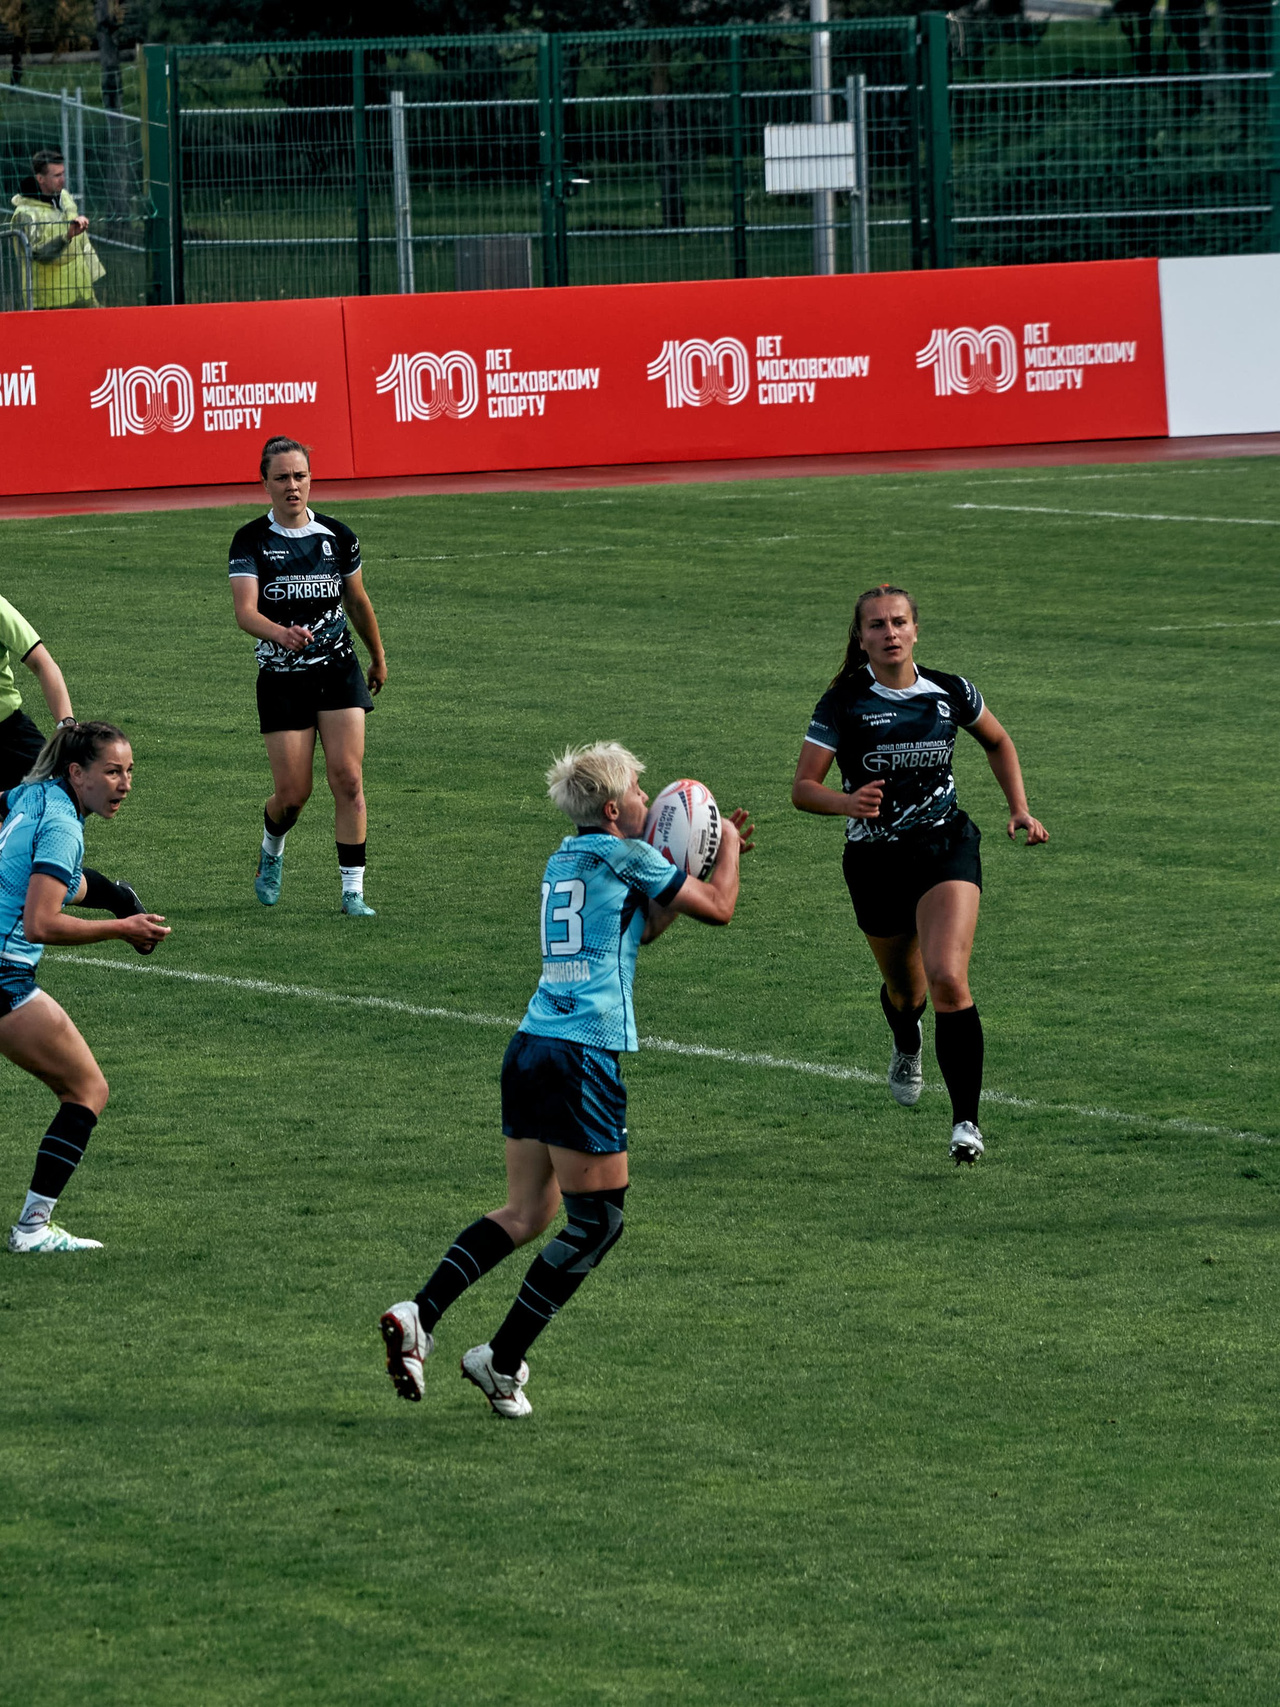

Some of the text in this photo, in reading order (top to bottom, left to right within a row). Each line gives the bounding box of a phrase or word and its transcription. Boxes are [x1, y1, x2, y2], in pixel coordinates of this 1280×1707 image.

[755, 335, 782, 357] ЛЕТ
[1022, 322, 1050, 345] ЛЕТ
[485, 348, 512, 370] ЛЕТ
[916, 325, 1018, 396] 100
[1024, 341, 1136, 369] МОСКОВСКОМУ
[201, 360, 228, 383] ЛЕТ
[647, 337, 750, 408] 100
[757, 356, 871, 381] МОСКОВСКОМУ
[1026, 368, 1084, 392] СПОРТУ
[202, 381, 317, 407] МОСКОВСКОМУ
[376, 350, 479, 423] 100
[486, 368, 601, 395] МОСКОВСКОМУ
[758, 381, 816, 404] СПОРТУ
[90, 364, 195, 437] 100
[488, 393, 545, 418] СПОРТУ
[204, 406, 263, 431] СПОРТУ
[657, 805, 670, 834] RUGBY
[663, 806, 677, 843] RUSSIAN
